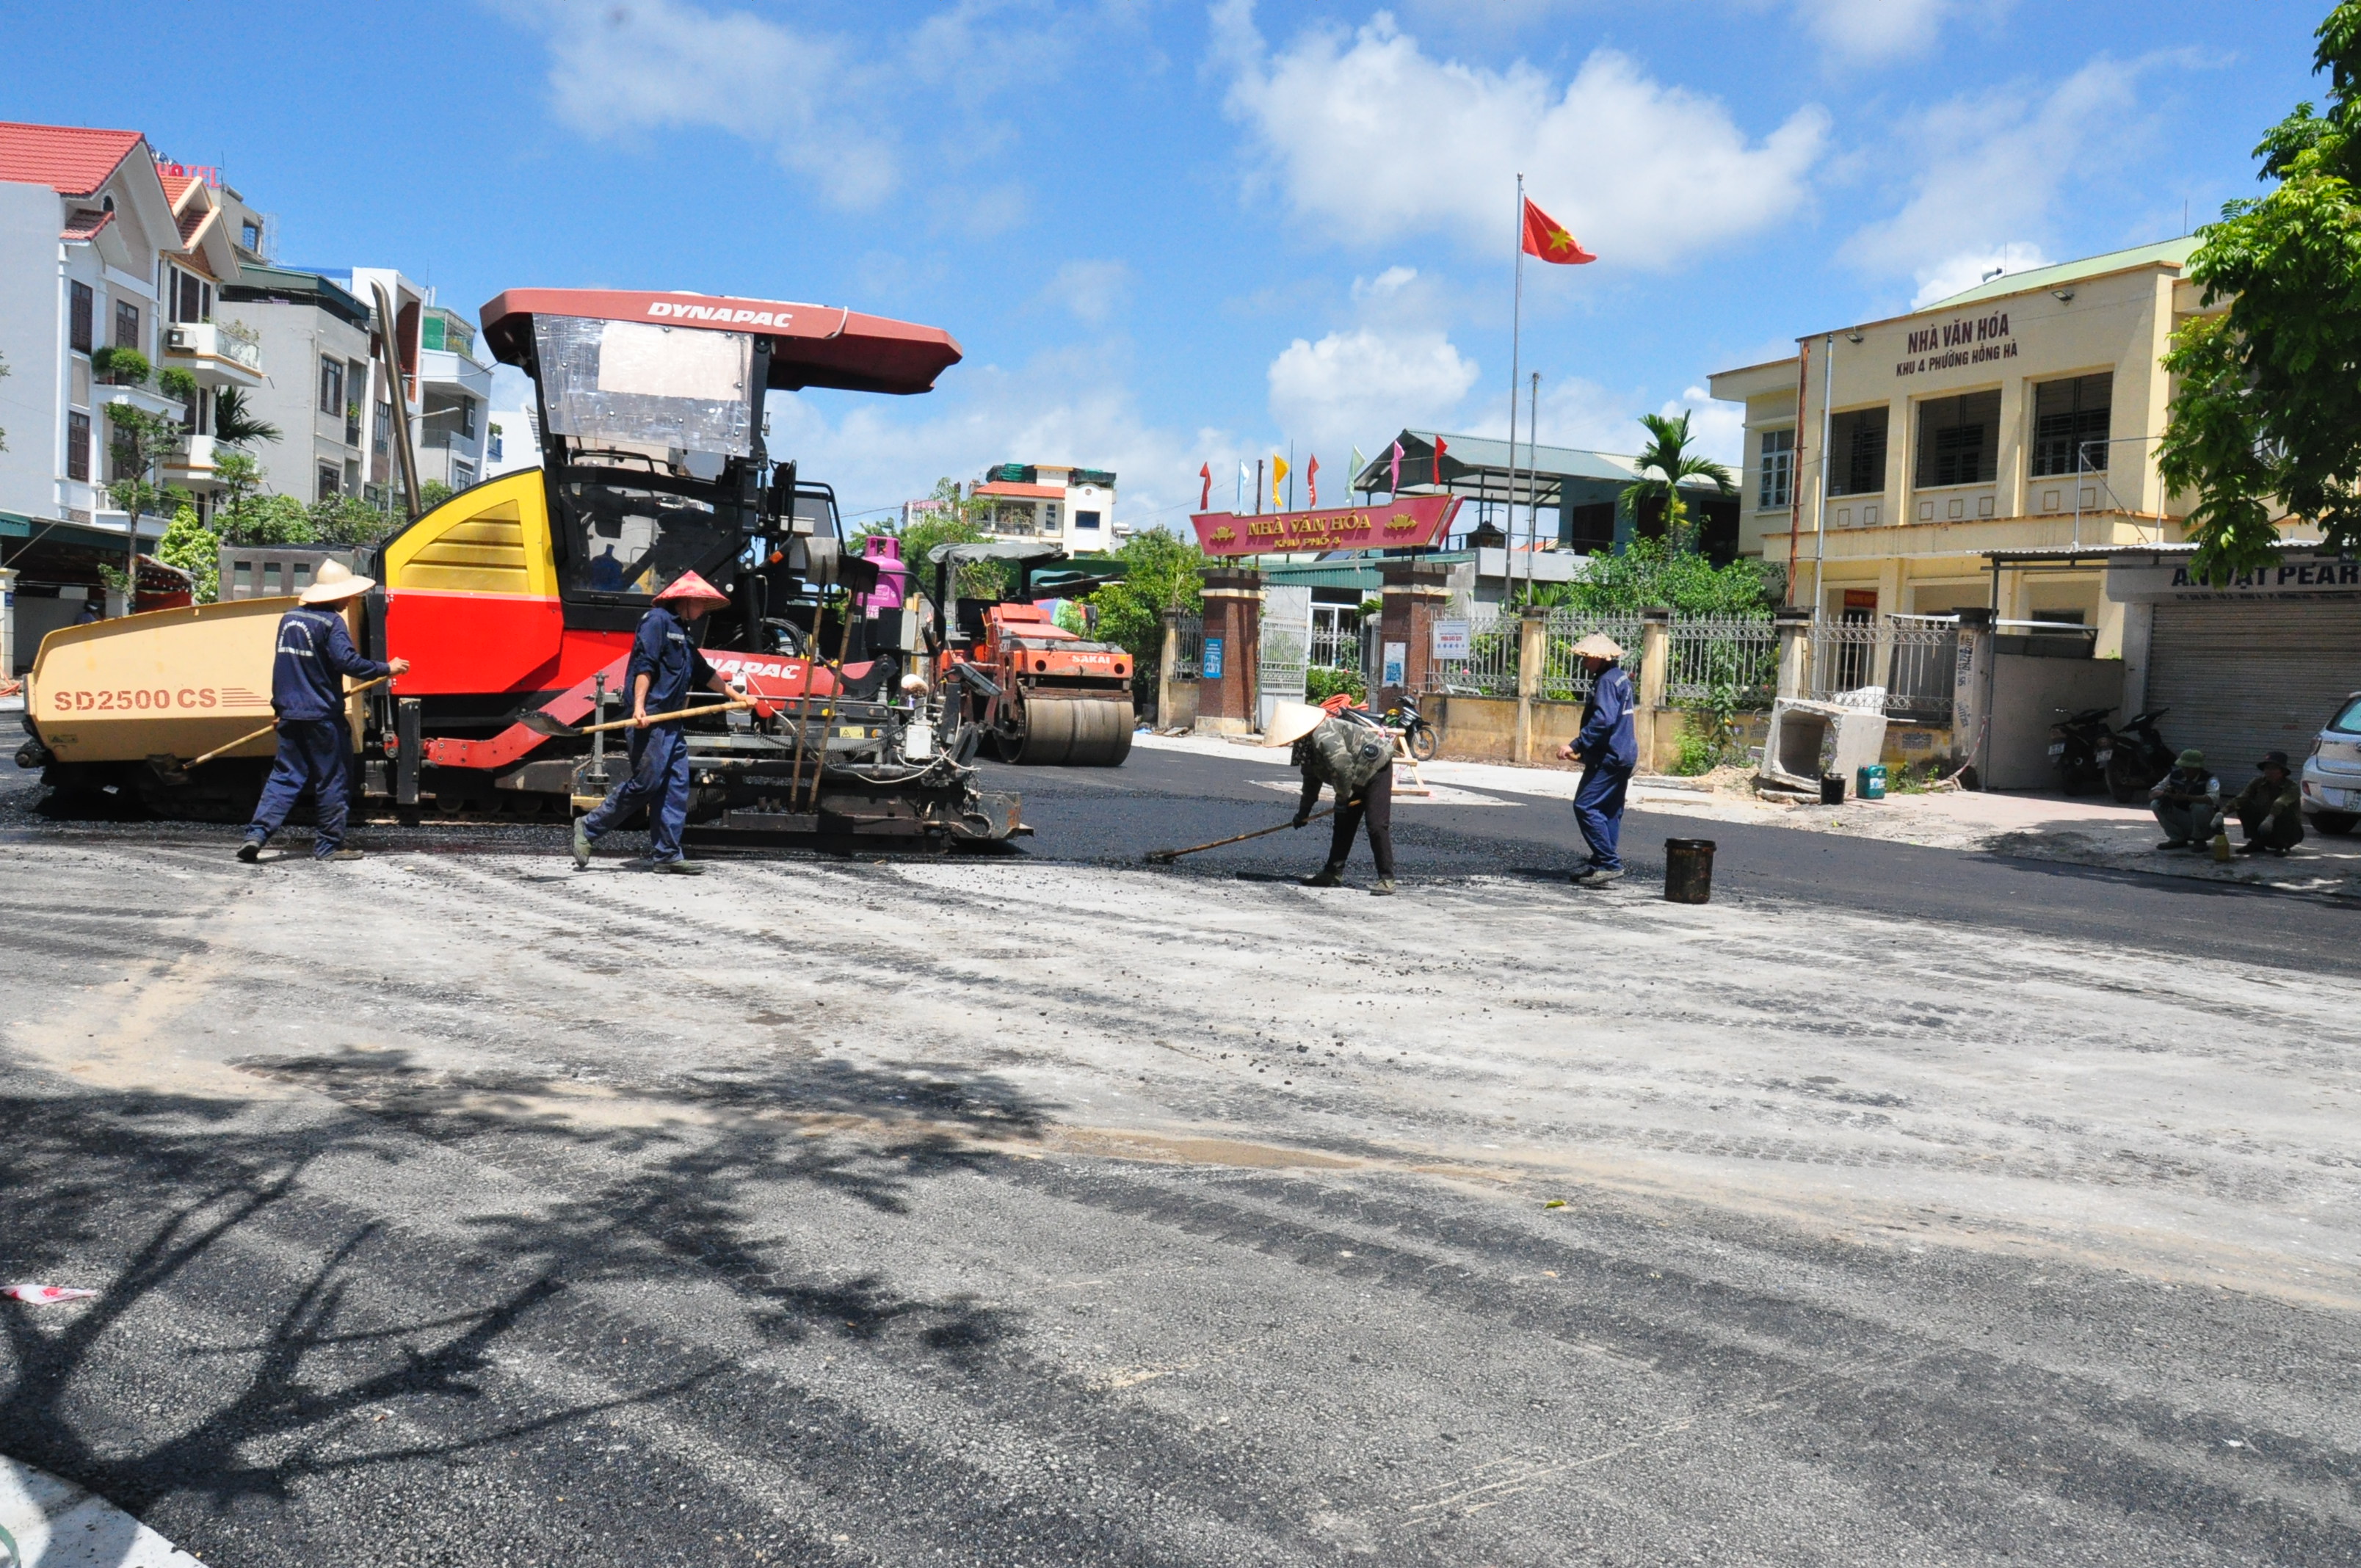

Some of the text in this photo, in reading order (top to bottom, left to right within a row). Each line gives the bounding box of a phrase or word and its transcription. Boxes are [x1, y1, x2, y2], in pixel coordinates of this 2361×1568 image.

[155, 162, 221, 188] HOTEL
[648, 302, 793, 327] DYNAPAC
[1907, 311, 2009, 354] NHÀ VĂN HÓA
[1896, 339, 2017, 377] KHU 4 PHƯỜNG HỒNG HÀ
[1247, 509, 1371, 536] NHÀ VĂN HÓA
[1274, 533, 1341, 548] KHU PHỐ 4
[705, 658, 801, 680] NAPAC
[1072, 655, 1111, 664] SAKAI
[54, 688, 217, 711] SD2500 CS
